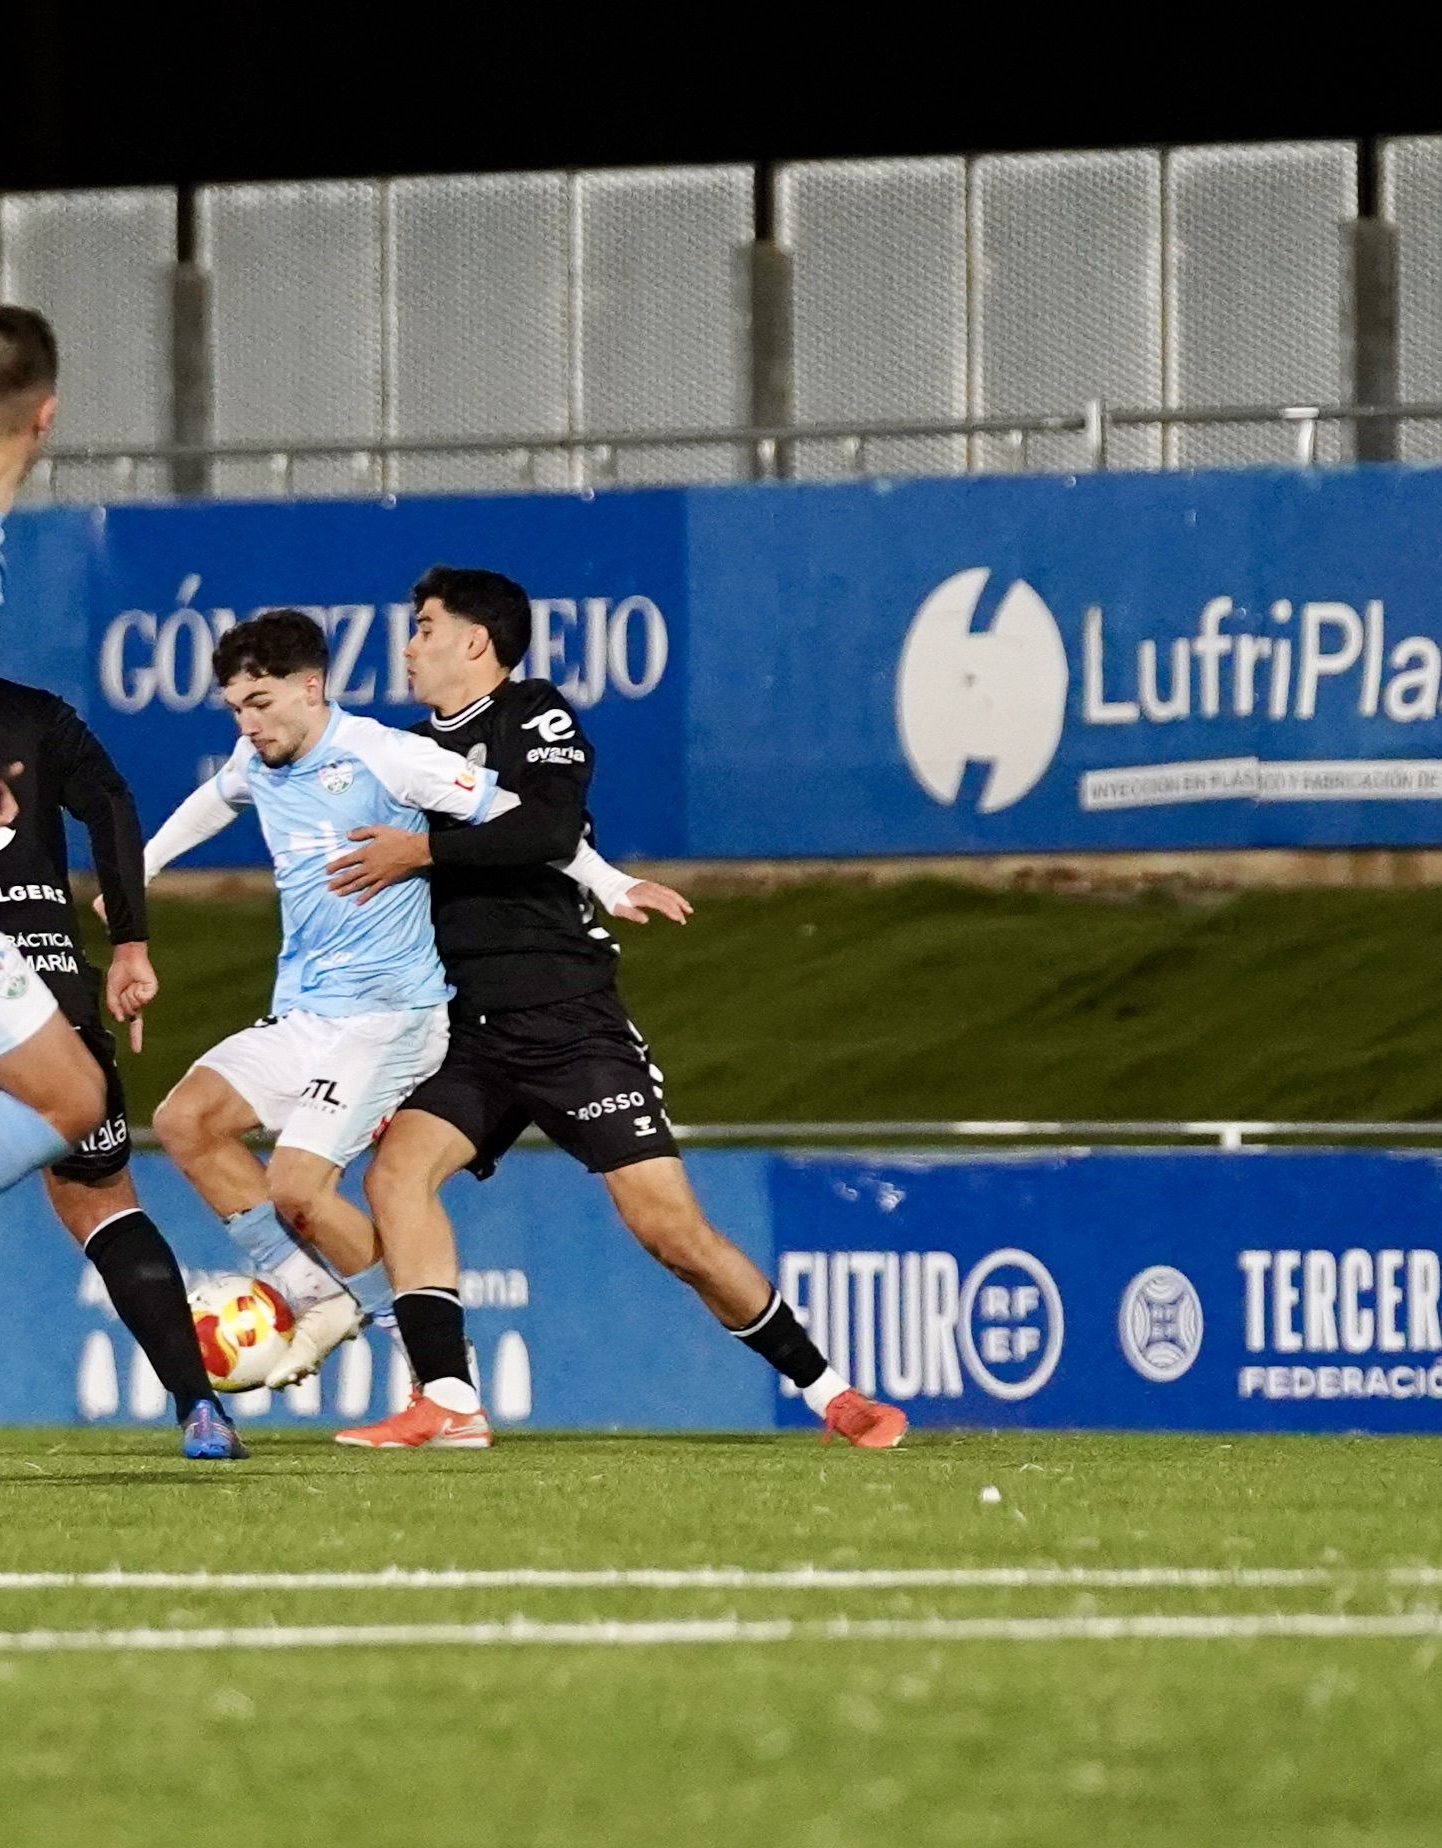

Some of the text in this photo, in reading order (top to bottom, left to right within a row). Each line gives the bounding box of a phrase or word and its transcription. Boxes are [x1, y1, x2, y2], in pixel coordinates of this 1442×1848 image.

[1082, 597, 1442, 722] LufriPla
[4, 932, 74, 949] RÁCTICA
[566, 1091, 645, 1121] ROSSO
[1237, 1248, 1442, 1354] TERCER
